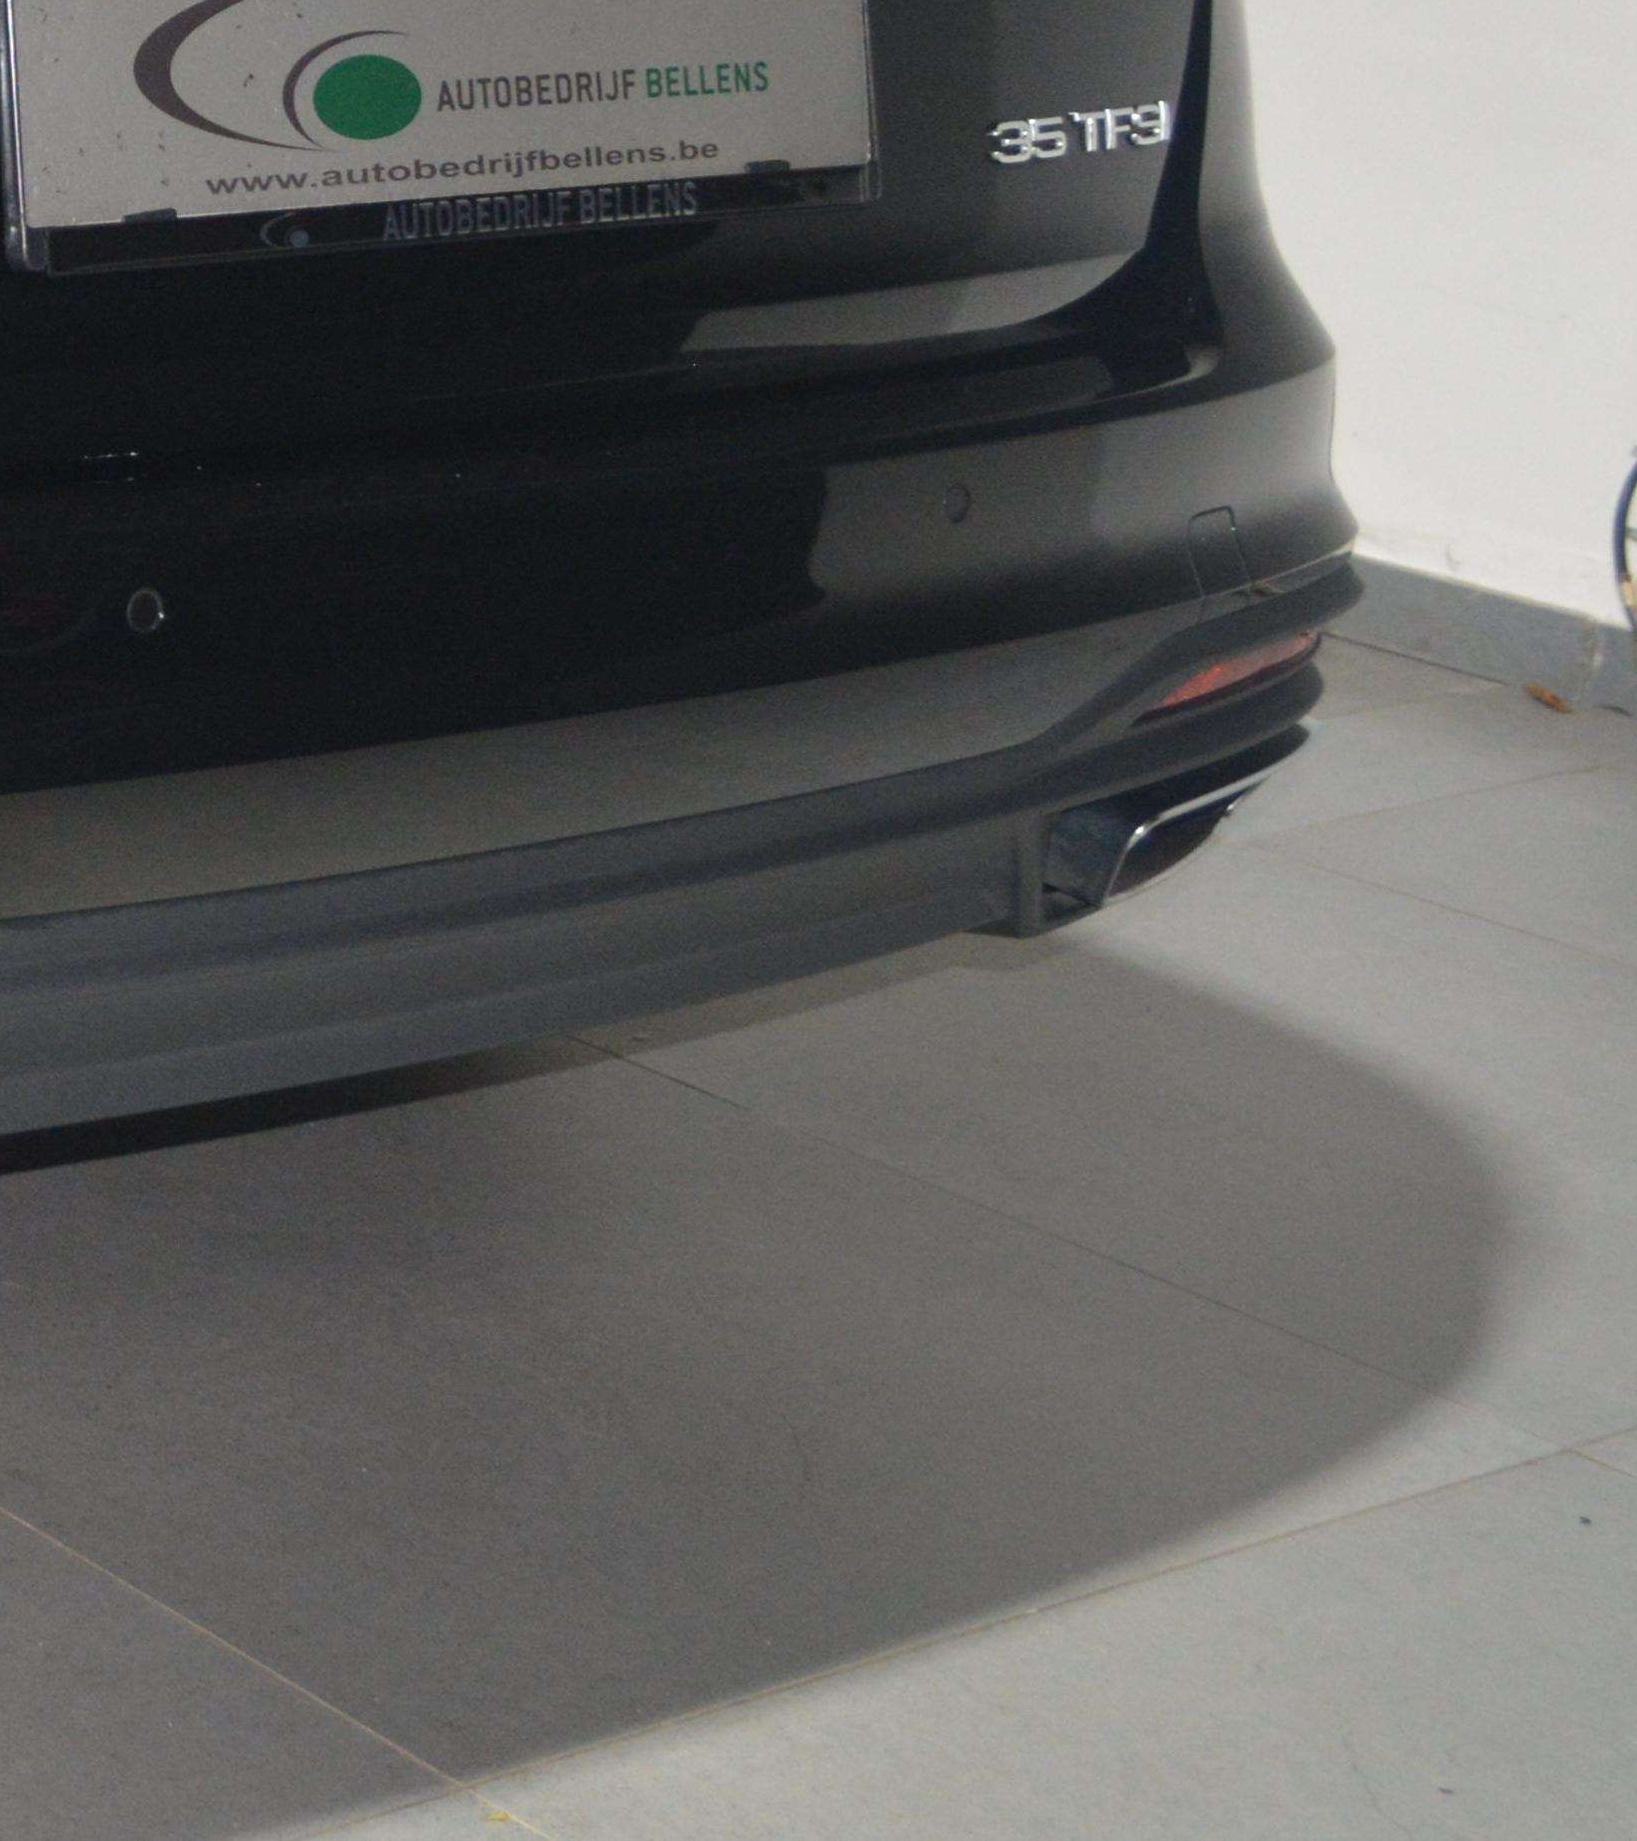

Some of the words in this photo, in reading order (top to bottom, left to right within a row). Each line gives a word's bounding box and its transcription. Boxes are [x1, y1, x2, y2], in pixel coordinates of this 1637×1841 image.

[437, 69, 636, 112] AUTOBEDRIJF
[644, 60, 770, 99] BELLENS
[986, 115, 1068, 164] 35
[1068, 100, 1170, 153] TFSI
[205, 139, 720, 195] www.autobedrijfbellens.be
[382, 190, 573, 242] AUTOBEDRIJF
[578, 180, 699, 226] BELLENS
